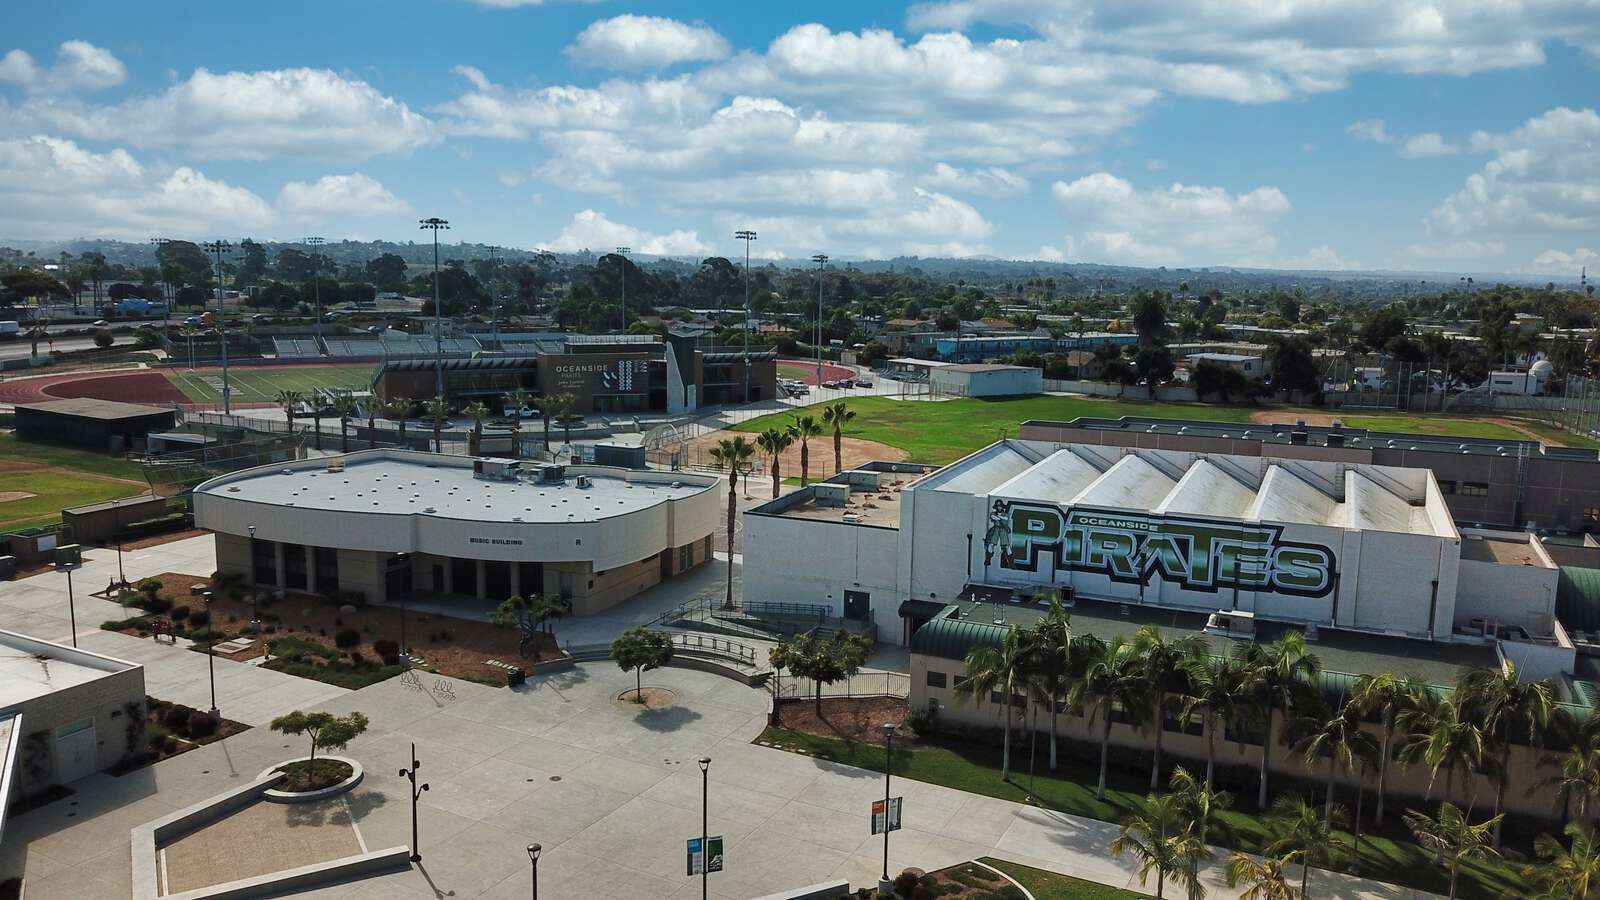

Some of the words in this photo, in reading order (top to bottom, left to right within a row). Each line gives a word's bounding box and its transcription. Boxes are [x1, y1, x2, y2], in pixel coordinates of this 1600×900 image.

[556, 365, 608, 373] OCEANSIDE
[1079, 517, 1159, 532] OCEANSIDE
[1008, 503, 1332, 593] PIRATES
